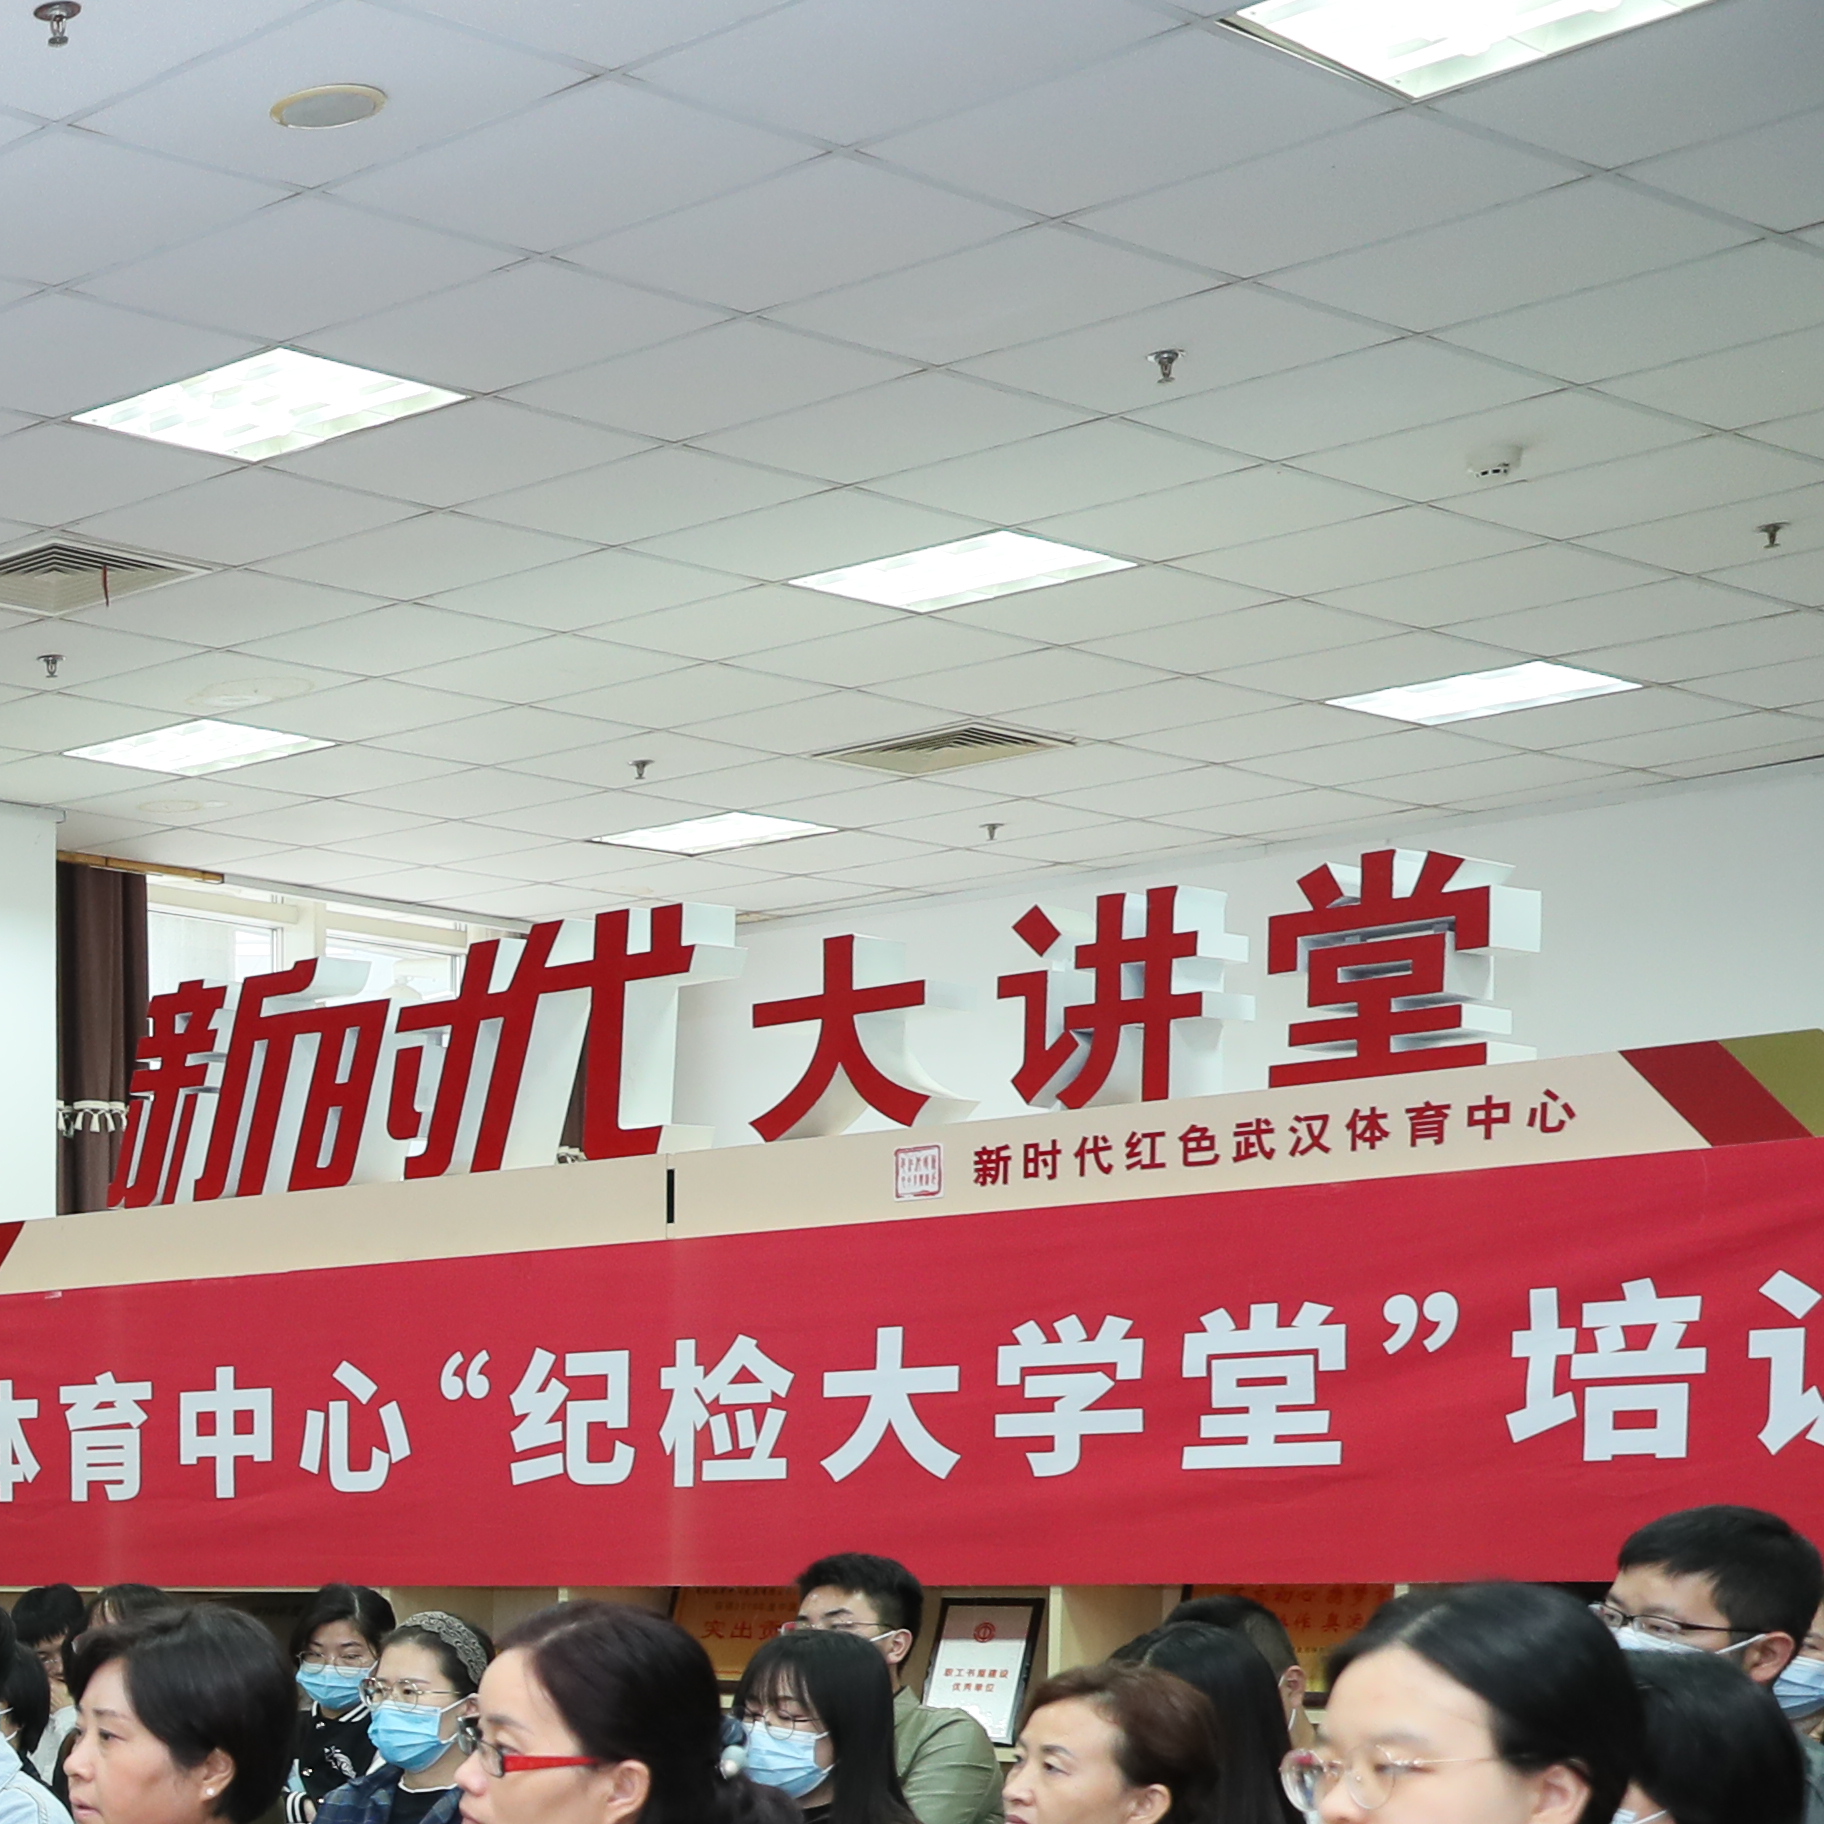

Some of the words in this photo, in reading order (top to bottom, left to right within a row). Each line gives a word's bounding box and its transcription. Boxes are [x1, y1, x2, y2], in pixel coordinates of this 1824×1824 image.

[973, 1088, 1577, 1187] 新时代红色武汉体育中心
[952, 1682, 995, 1693] 优秀单位
